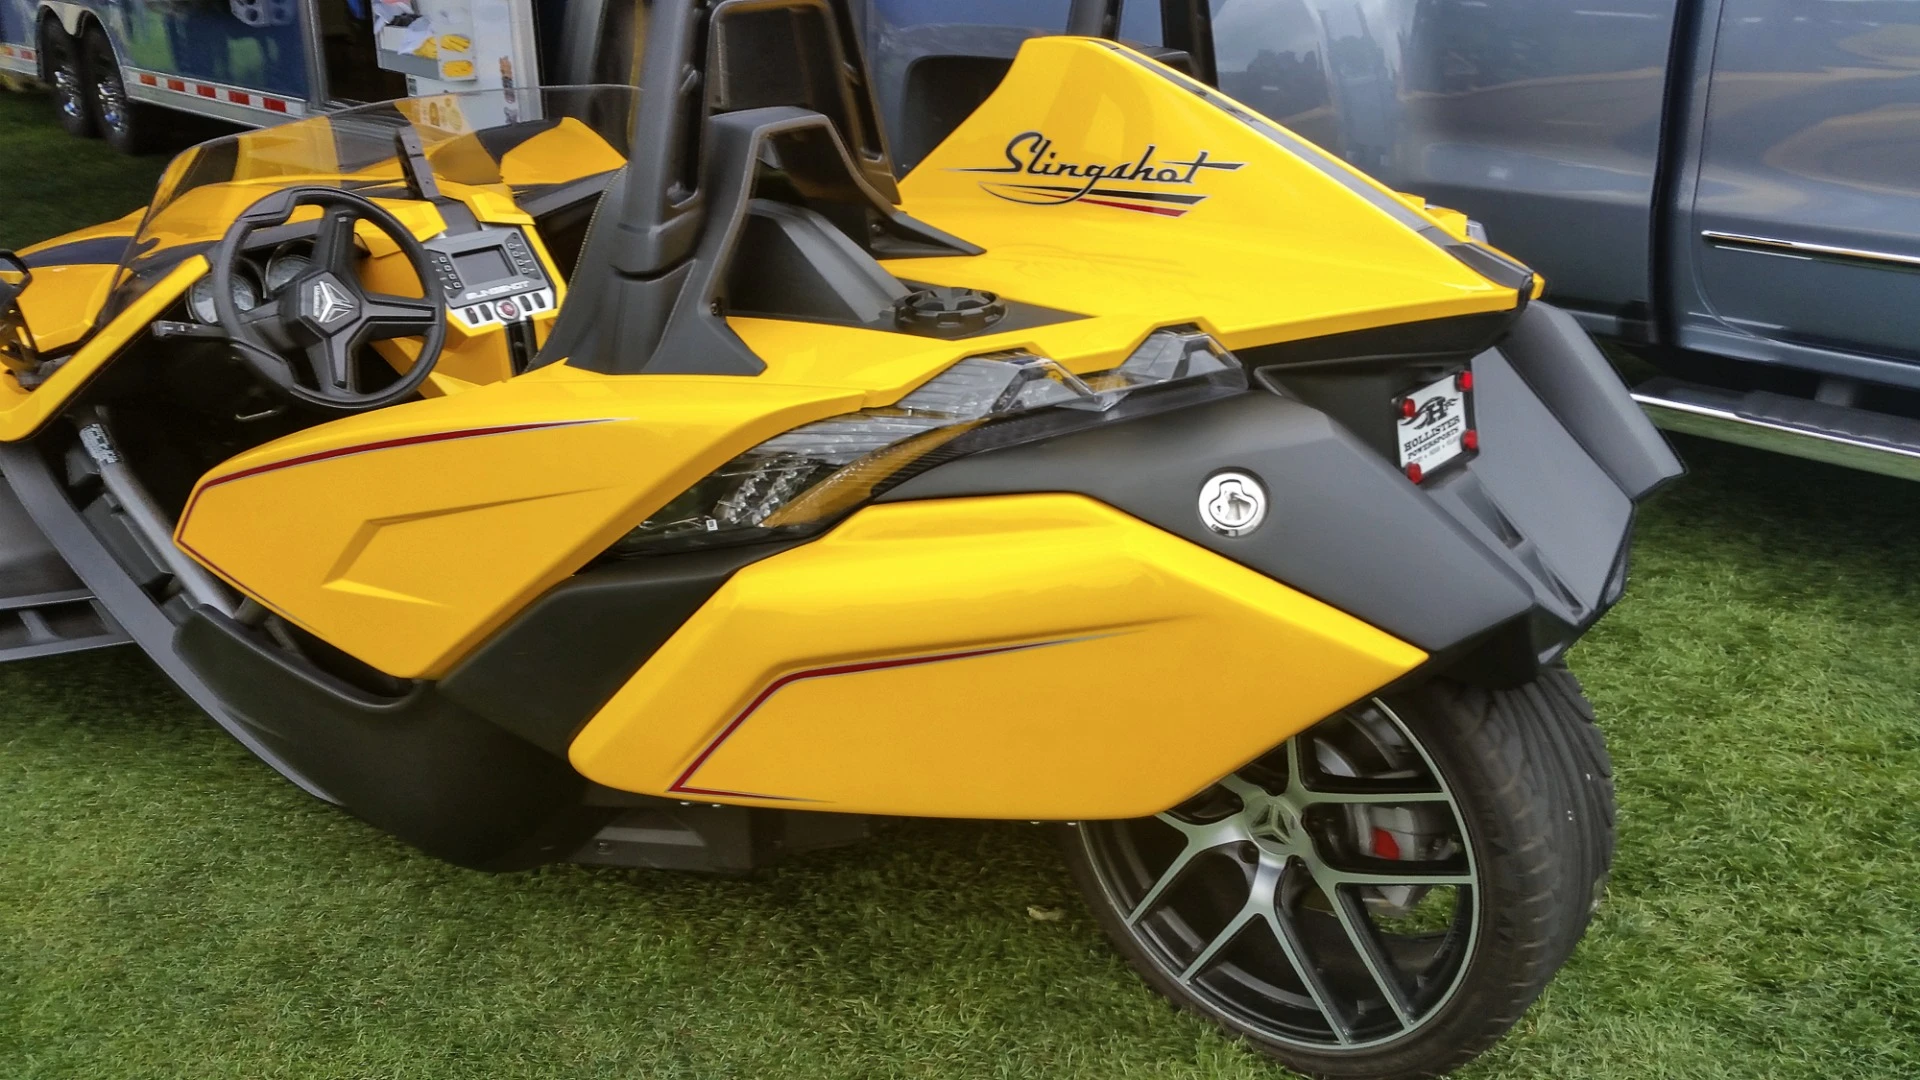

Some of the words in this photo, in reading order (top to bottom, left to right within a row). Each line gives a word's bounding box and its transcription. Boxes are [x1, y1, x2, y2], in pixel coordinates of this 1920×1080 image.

[955, 130, 1246, 205] Slingshot
[1403, 415, 1461, 452] HOLLISTER
[1407, 427, 1459, 460] POWERSPORTS
